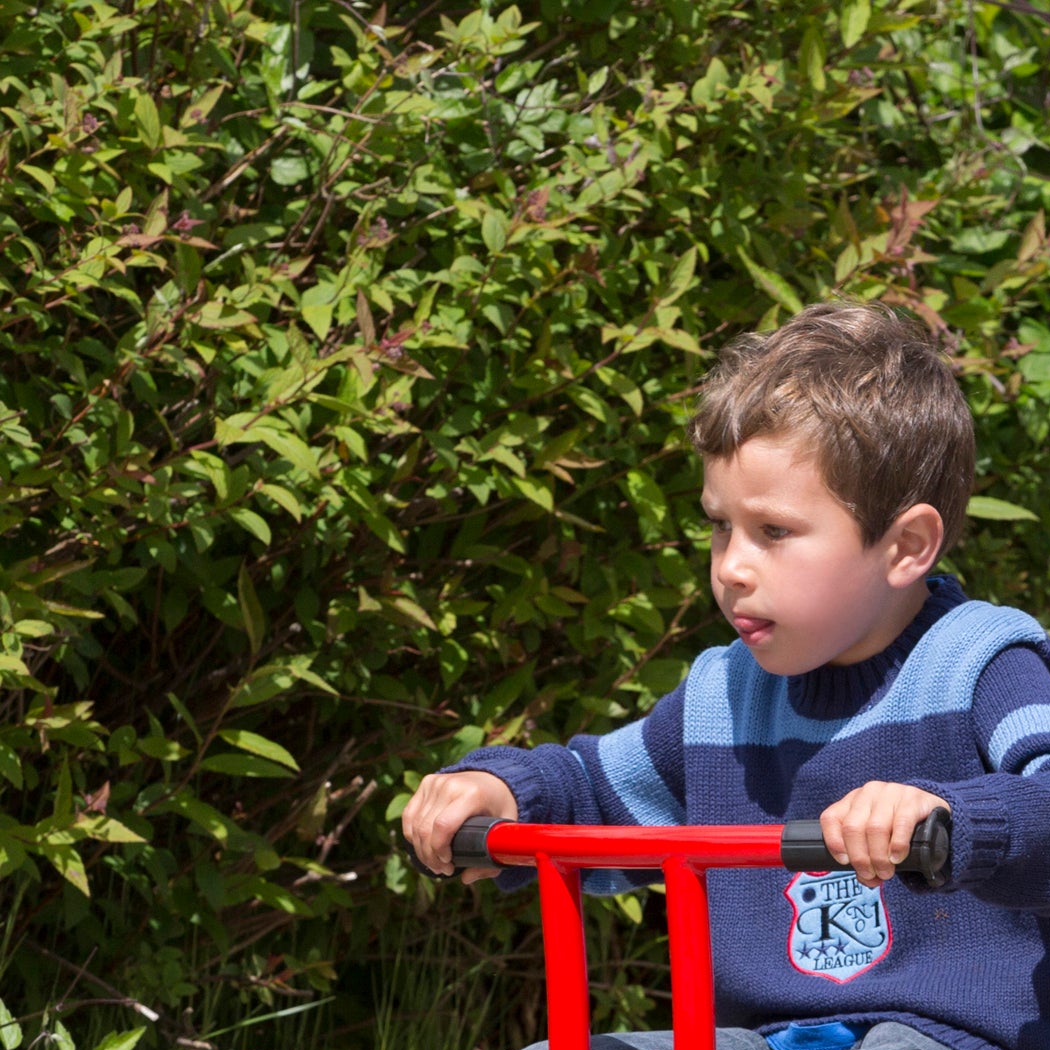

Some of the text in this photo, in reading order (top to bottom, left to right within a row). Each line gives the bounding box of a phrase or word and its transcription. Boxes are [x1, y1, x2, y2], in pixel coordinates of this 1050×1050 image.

[821, 877, 863, 902] THE
[797, 899, 886, 949] K
[813, 950, 873, 970] LEAGUE
